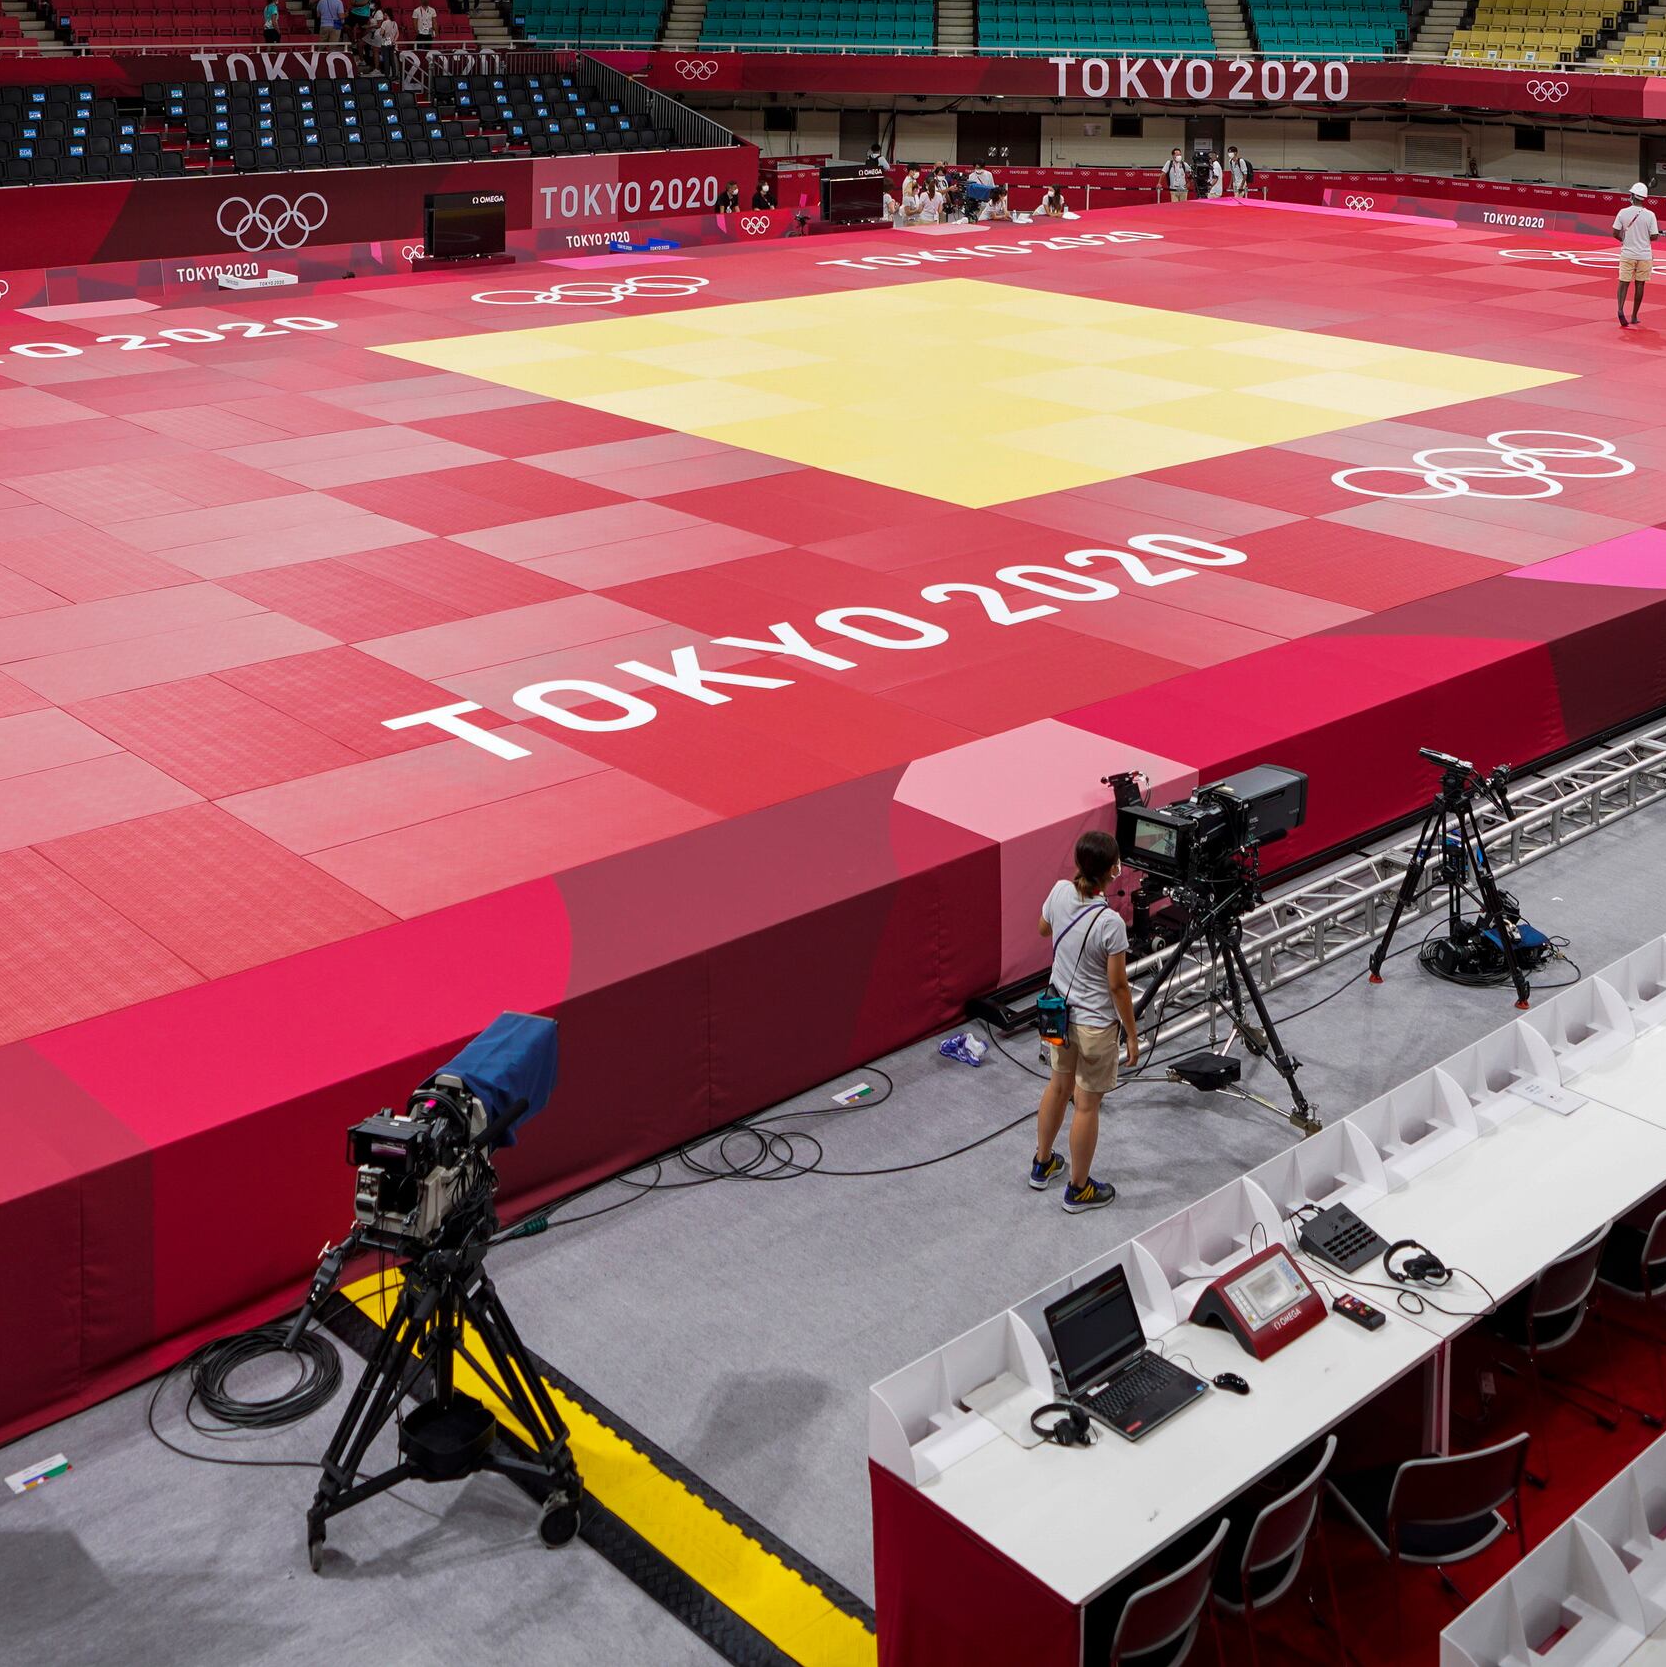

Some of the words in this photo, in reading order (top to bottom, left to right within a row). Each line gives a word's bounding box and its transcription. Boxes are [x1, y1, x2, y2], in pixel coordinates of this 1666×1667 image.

[190, 51, 355, 82] TOKYO
[1048, 56, 1214, 99] TOKYO
[1228, 60, 1349, 102] 2020
[864, 168, 883, 176] OMEGA
[479, 195, 504, 203] OMEGA
[540, 182, 642, 220] TOKYO
[648, 176, 719, 212] 2020
[1483, 212, 1516, 227] TOKYO
[1518, 217, 1544, 229] 2020
[566, 234, 603, 248] TOKYO
[604, 231, 630, 245] 2020
[815, 244, 1032, 270] TOKYO
[1017, 231, 1164, 250] 2020
[176, 265, 221, 283] TOKYO
[223, 263, 259, 279] 2020
[95, 316, 339, 351] 2020
[383, 606, 949, 762] TOKYO
[921, 533, 1248, 626] 2020
[1280, 1308, 1302, 1325] OMEGA
